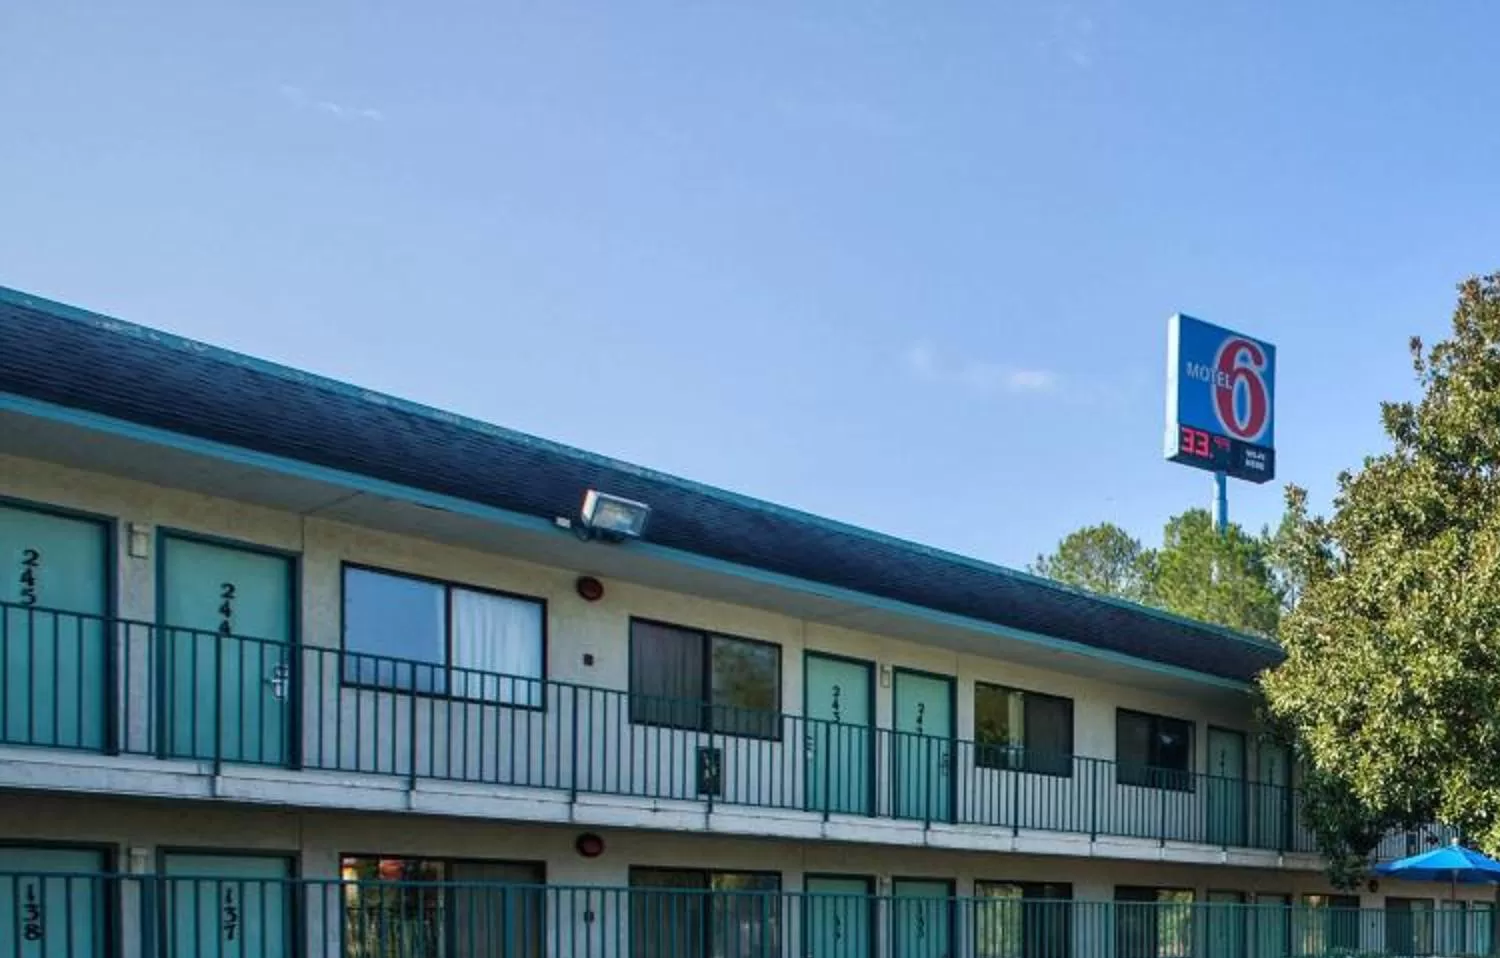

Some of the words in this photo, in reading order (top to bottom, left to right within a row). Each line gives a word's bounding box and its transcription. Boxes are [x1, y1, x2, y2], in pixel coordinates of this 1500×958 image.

[1186, 361, 1233, 390] MOTEL
[1212, 335, 1270, 443] 6
[20, 549, 40, 604] 245
[218, 583, 236, 637] 244
[24, 884, 44, 940] 138
[224, 887, 237, 941] 137
